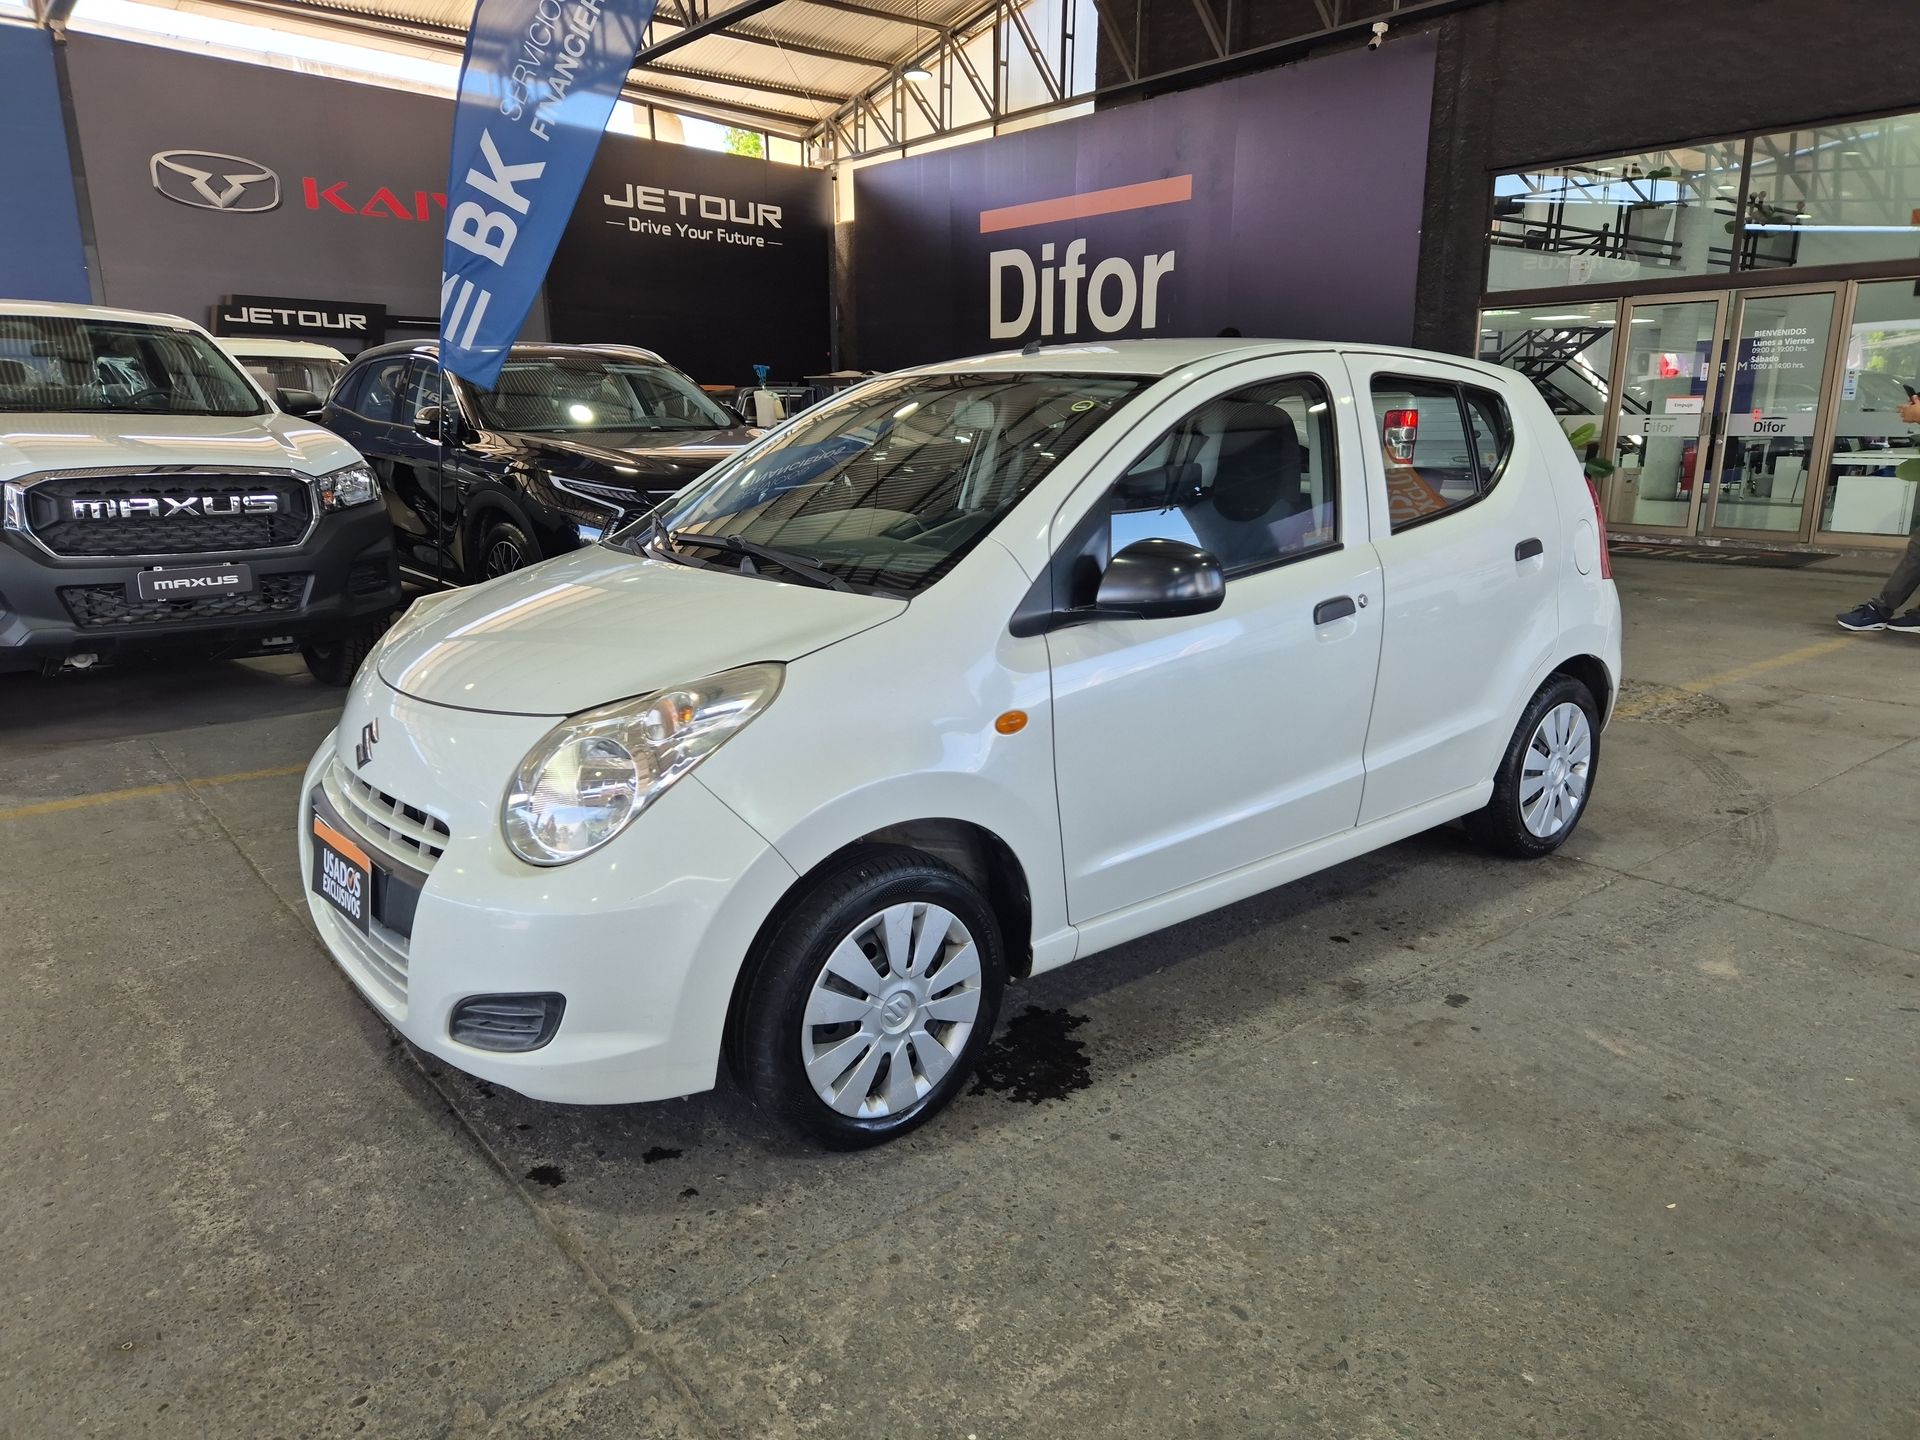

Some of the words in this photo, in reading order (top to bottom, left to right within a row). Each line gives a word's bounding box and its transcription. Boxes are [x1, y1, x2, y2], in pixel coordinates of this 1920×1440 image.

[446, 127, 547, 267] BK
[603, 183, 782, 229] JETOUR
[628, 216, 672, 236] Drive
[675, 222, 713, 241] Your
[717, 228, 765, 247] Future
[990, 238, 1175, 339] Difor
[224, 306, 367, 330] JETOUR
[1753, 339, 1776, 347] Lunes
[1784, 337, 1815, 345] Viernes
[1754, 328, 1807, 338] BIENVENIDOS
[1750, 355, 1779, 363] Sábado
[1751, 346, 1769, 354] 09:00
[1792, 361, 1805, 369] hrs.
[1643, 421, 1674, 433] Difor
[1753, 421, 1786, 433] Difor
[72, 494, 278, 519] MAXUS
[154, 575, 238, 590] MAXUS
[323, 848, 361, 897] USADOS
[323, 872, 361, 919] EXCLUSIVOS
